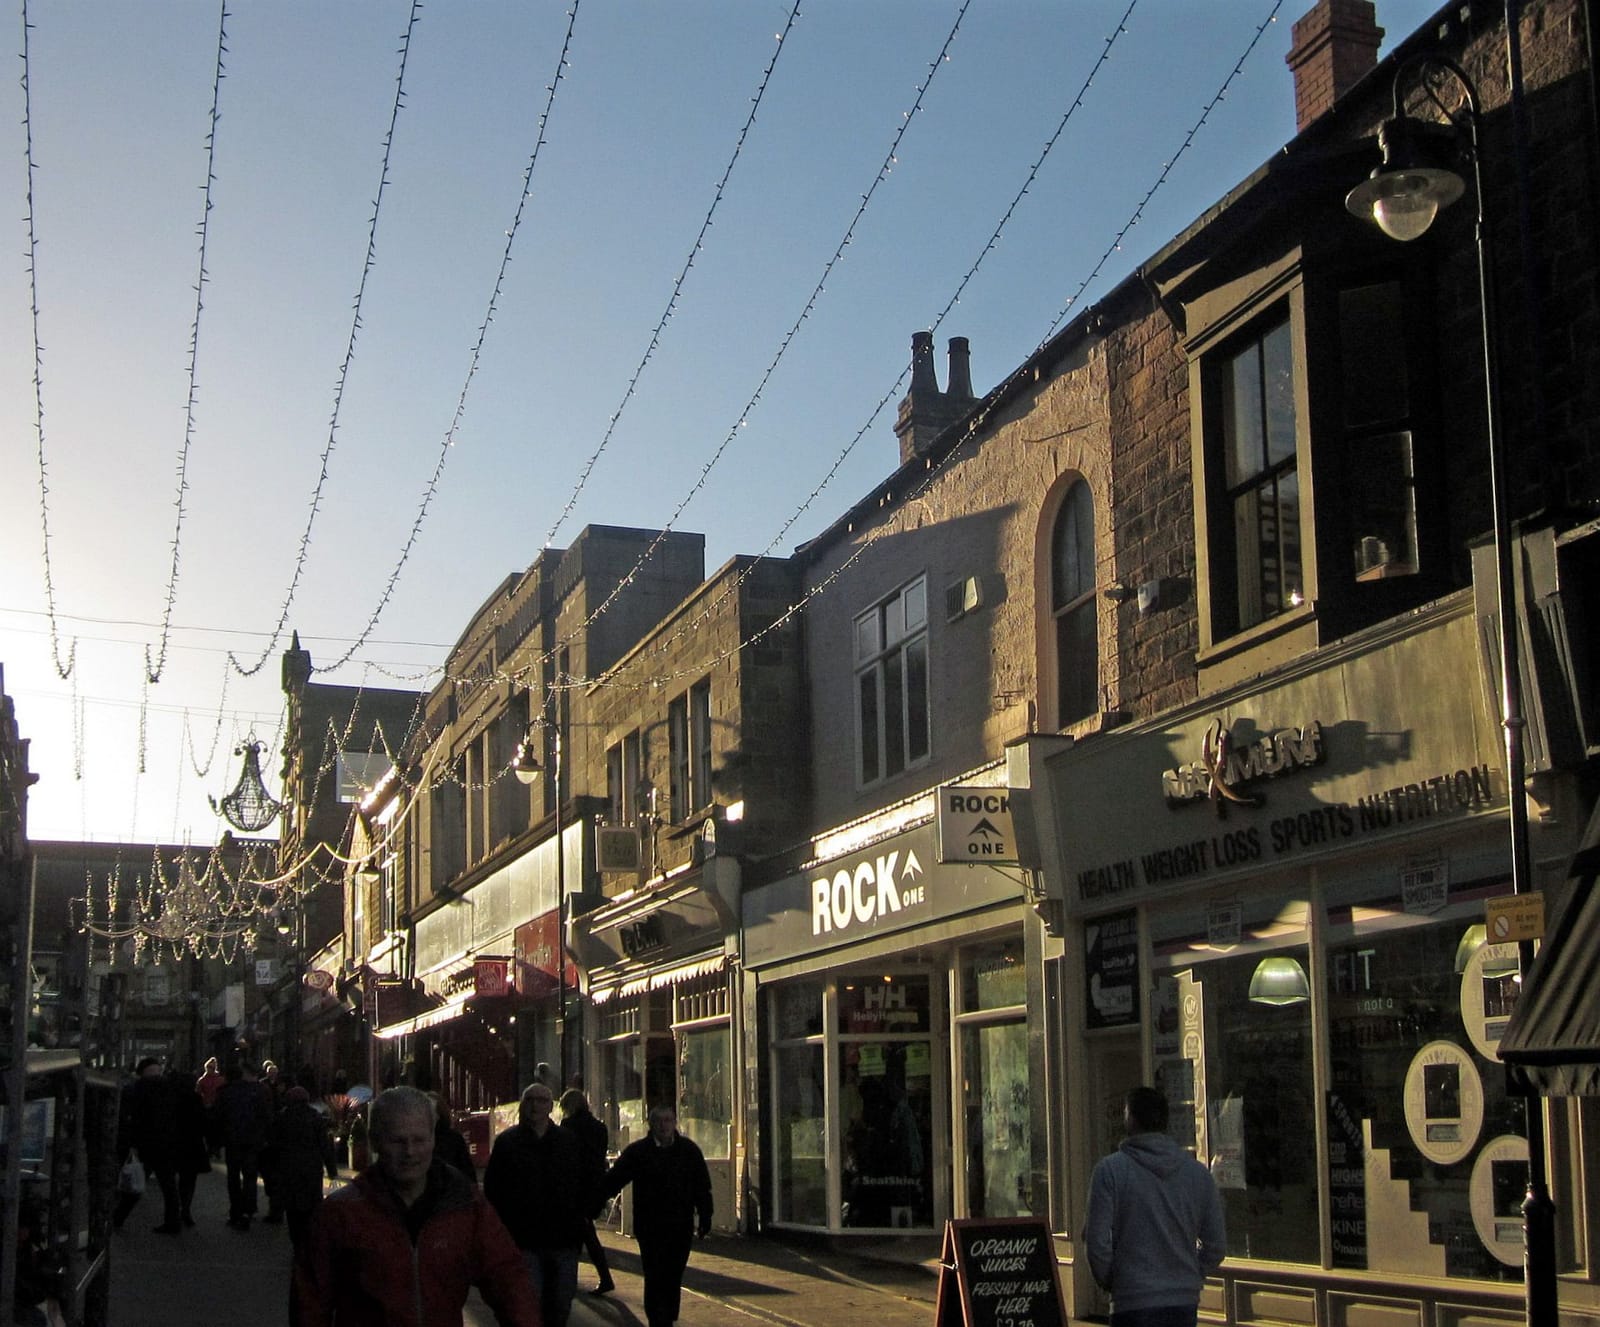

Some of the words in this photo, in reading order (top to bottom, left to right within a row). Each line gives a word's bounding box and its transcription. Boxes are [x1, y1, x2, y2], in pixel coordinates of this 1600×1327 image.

[950, 794, 1013, 814] ROCK
[1077, 859, 1135, 900] HEALTH
[1141, 840, 1207, 885] WEIGHT
[1211, 827, 1262, 868] LOSS
[1270, 803, 1354, 853] SPORTS
[1358, 763, 1493, 832] NUTRITION
[968, 842, 1005, 856] ONE
[811, 850, 901, 936] ROCK
[902, 885, 926, 909] ONE
[969, 1237, 1038, 1258] ORGANIC
[979, 1257, 1027, 1273] JUICES
[971, 1280, 1021, 1297] FRESHLY
[1021, 1279, 1052, 1295] MADE
[994, 1296, 1033, 1315] HERE
